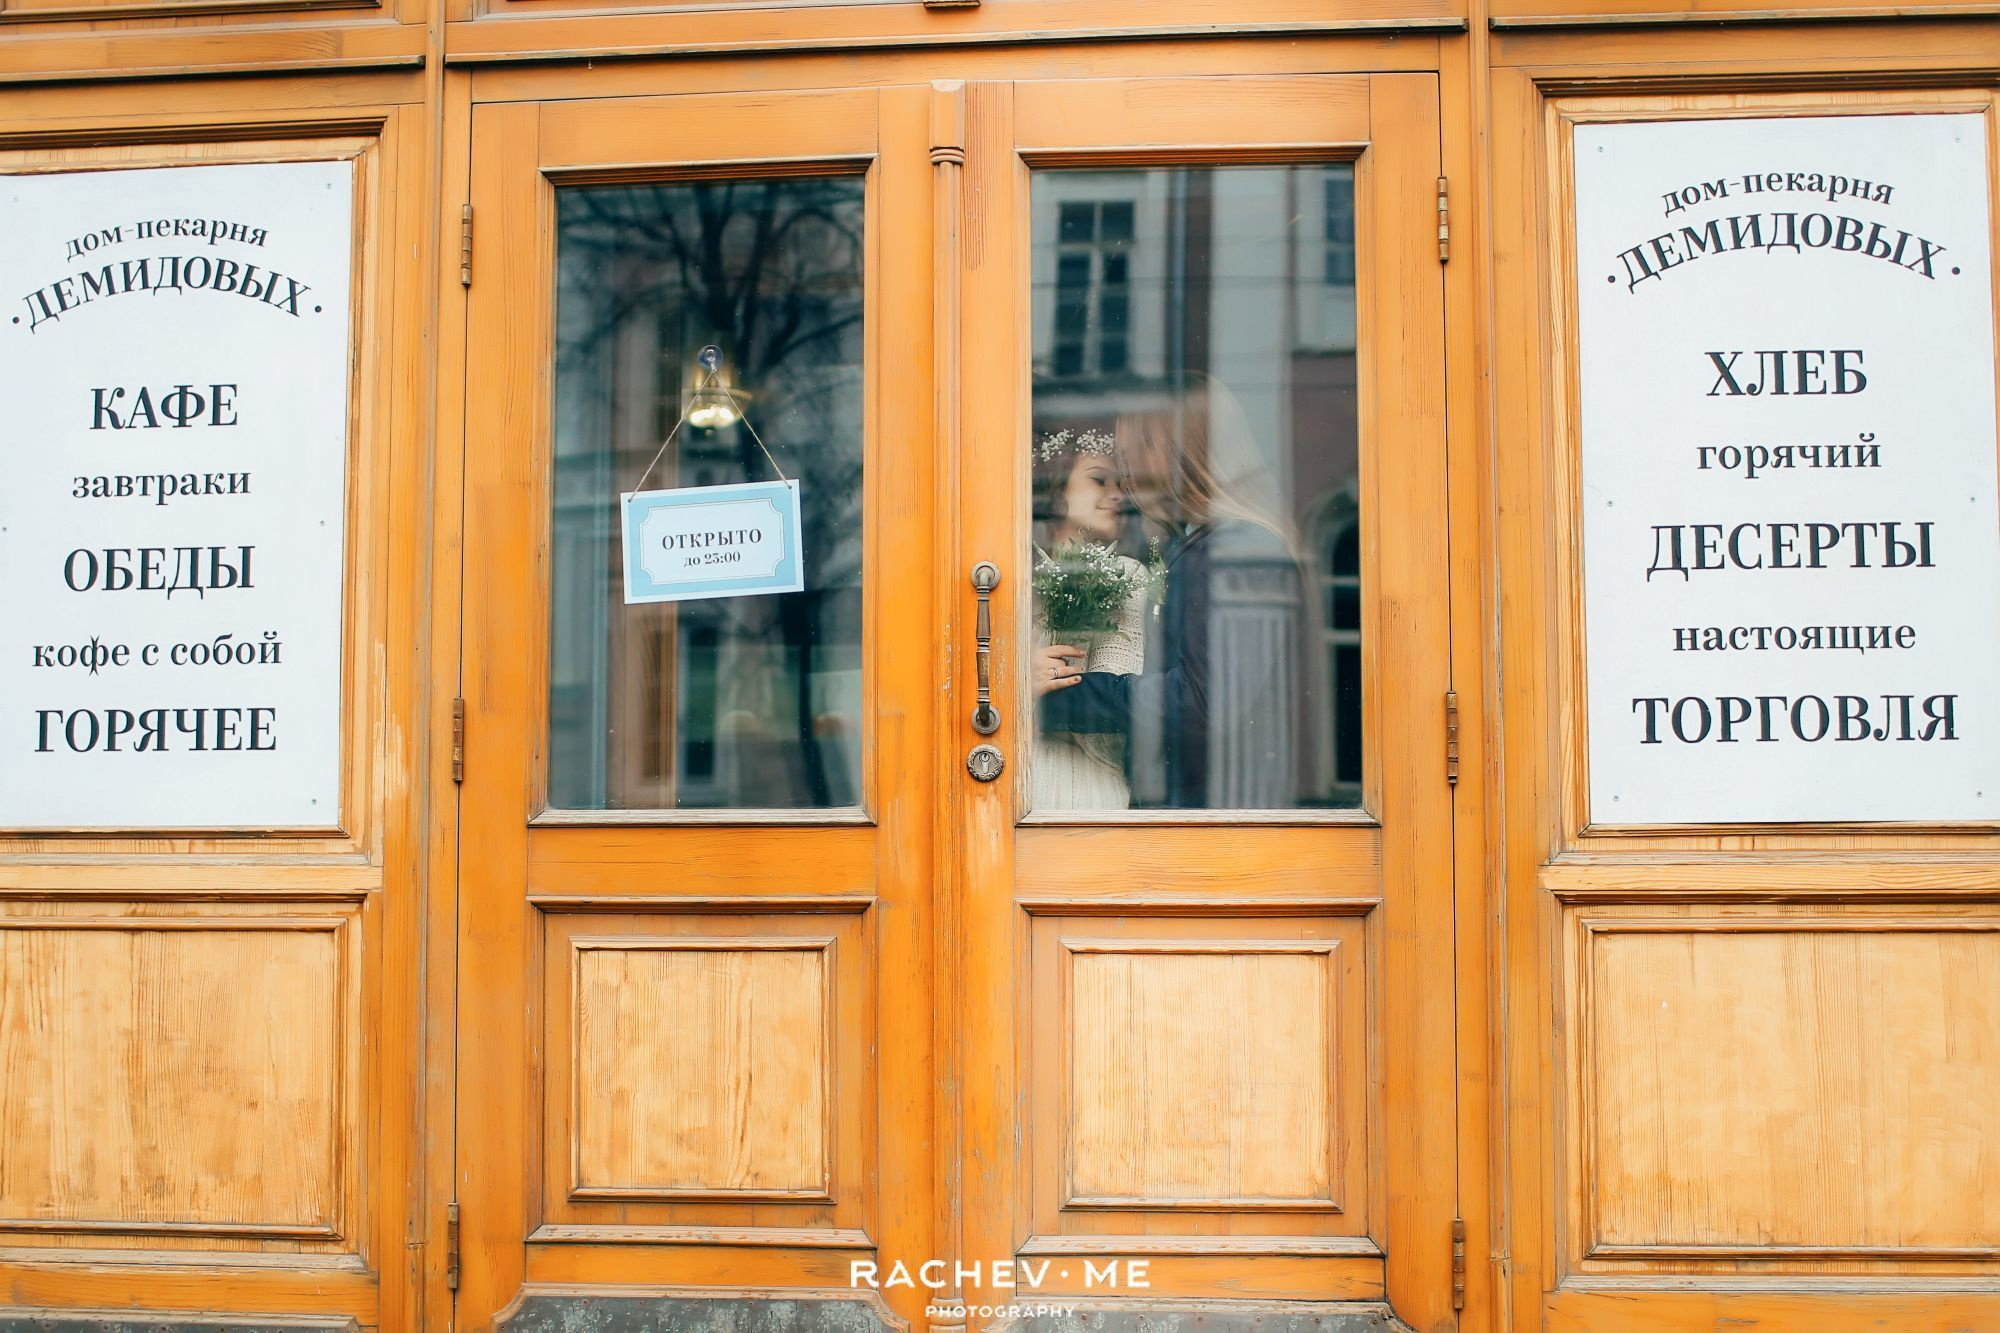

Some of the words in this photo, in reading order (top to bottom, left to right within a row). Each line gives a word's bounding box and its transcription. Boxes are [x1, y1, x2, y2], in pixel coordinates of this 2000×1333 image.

[1661, 172, 1895, 218] дом-пекарня
[65, 218, 268, 262] дом-пекарня
[1616, 212, 1947, 294] ДЕМИДОВЫХ
[22, 255, 311, 335] ДЕМИДОВЫХ
[1704, 349, 1867, 397] ХЛЕБ
[89, 383, 238, 430] КАФЕ
[1696, 432, 1882, 480] горячий
[72, 472, 251, 506] завтраки
[662, 528, 762, 550] ОТКРЫТО
[683, 556, 701, 568] до
[1646, 521, 1936, 583] ДЕСЕРТЫ
[63, 545, 256, 600] ОБЕДЫ
[32, 636, 130, 676] кофе
[141, 643, 159, 666] с
[170, 630, 282, 666] собой
[1672, 625, 1916, 655] настоящие
[34, 707, 277, 753] ГОРЯЧЕЕ
[1632, 694, 1960, 744] ТОРГОВЛЯ
